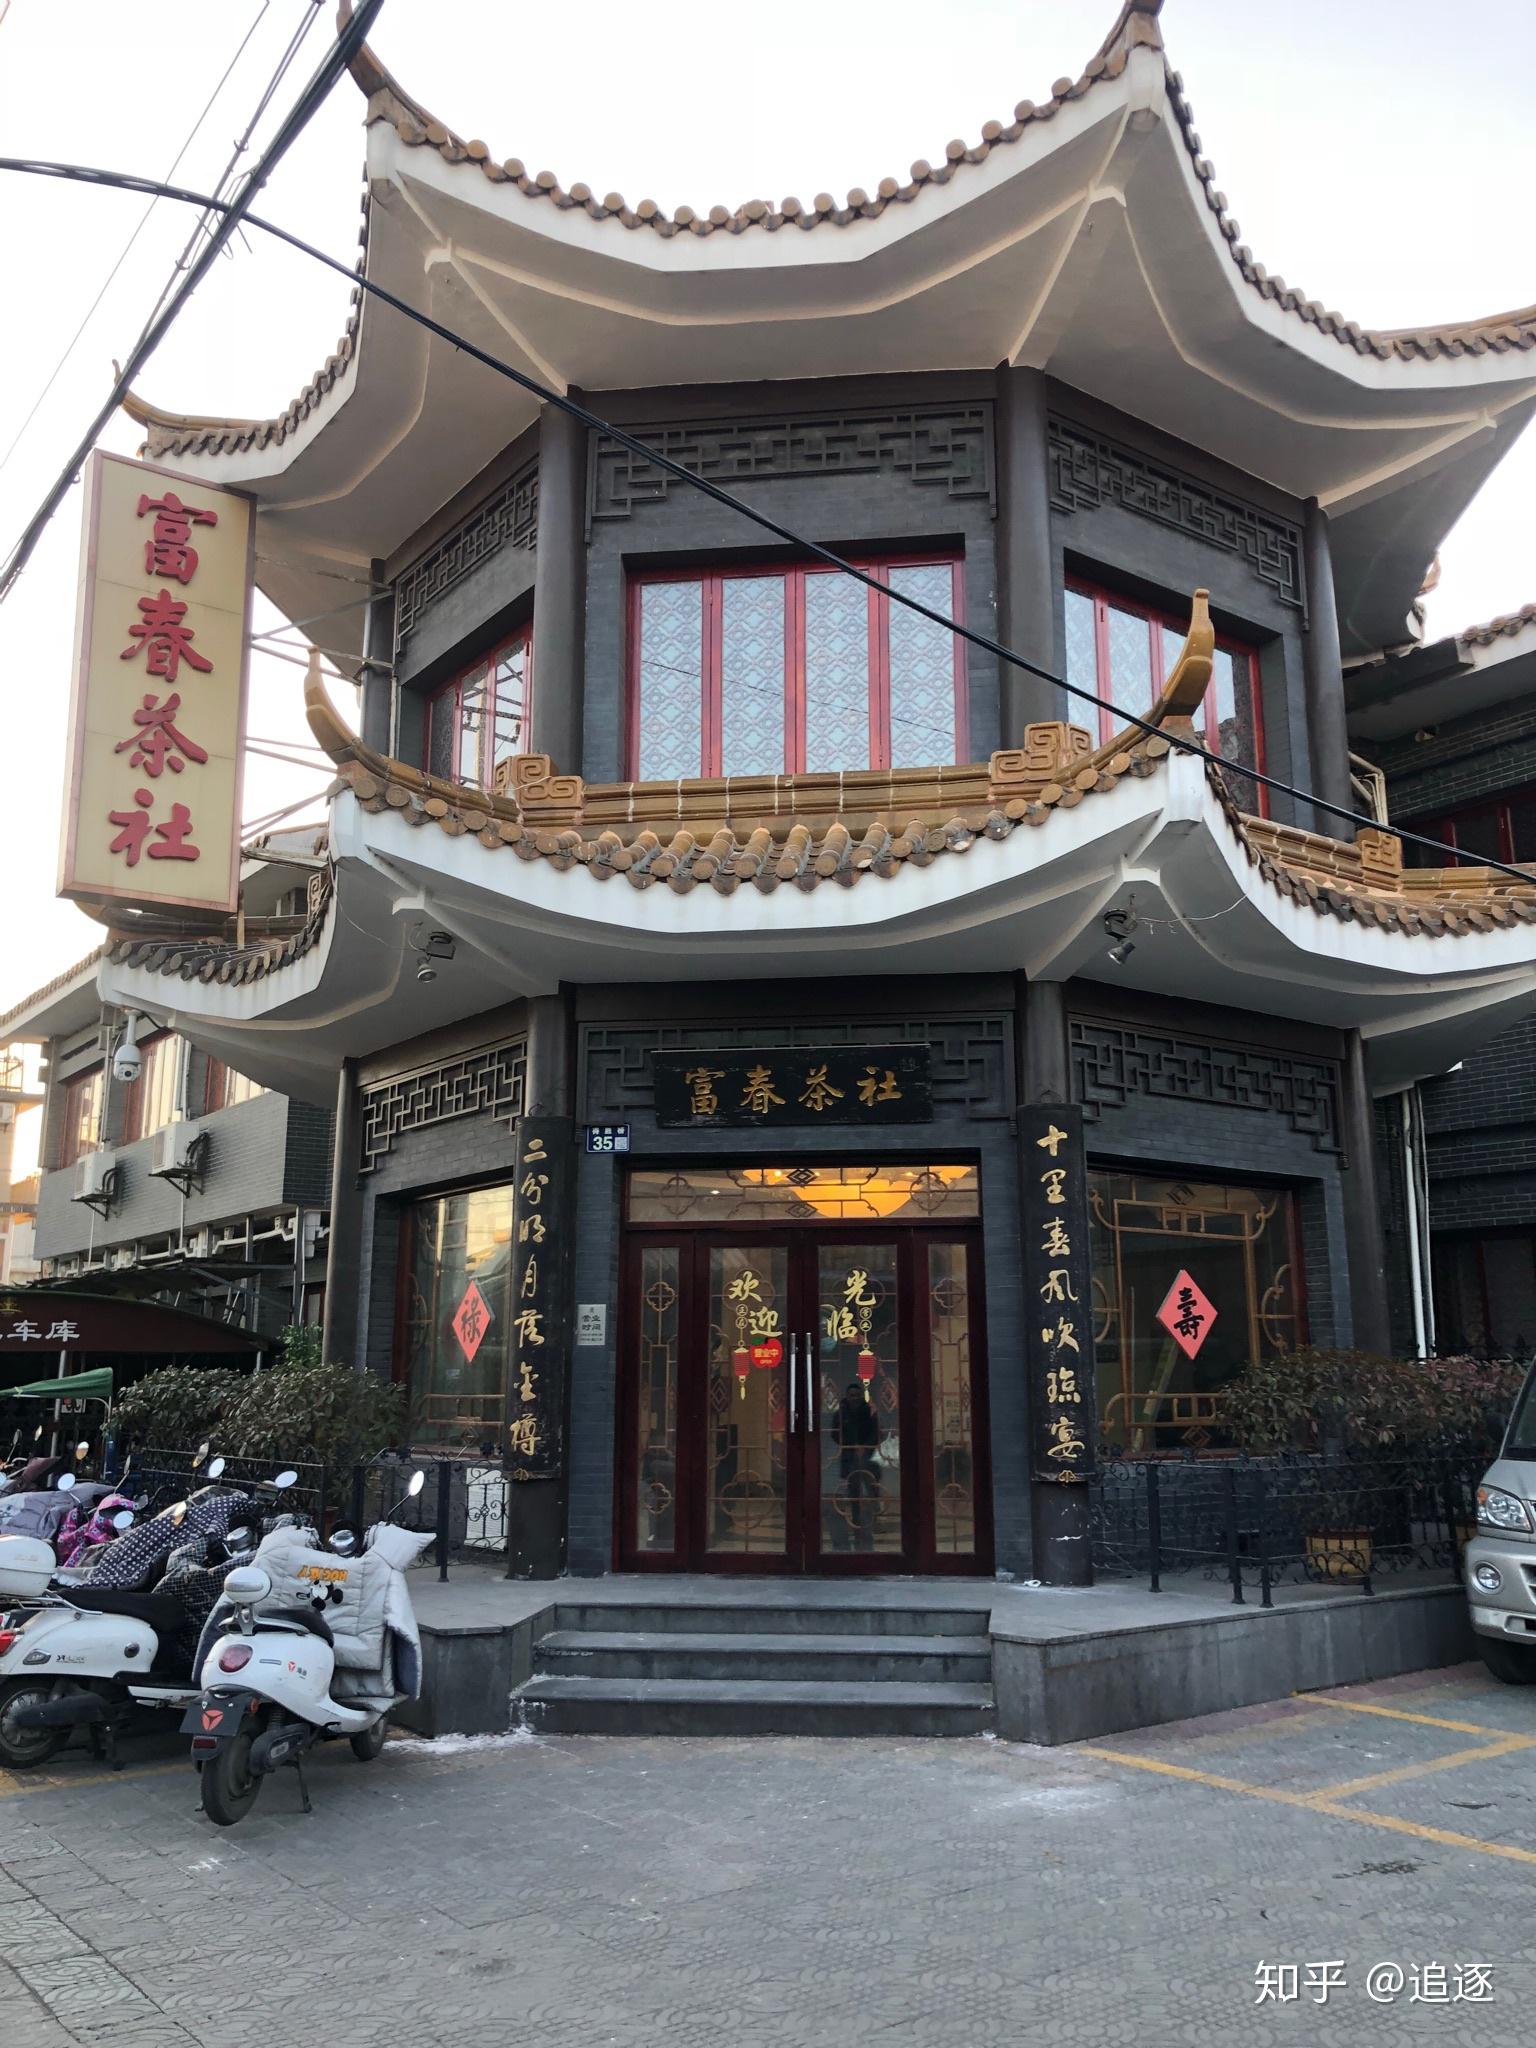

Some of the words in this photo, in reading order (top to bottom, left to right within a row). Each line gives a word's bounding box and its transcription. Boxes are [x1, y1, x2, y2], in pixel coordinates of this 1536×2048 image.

[108, 491, 218, 867] 富春茶社
[685, 1064, 903, 1114] 富春茶社
[592, 1136, 613, 1151] 35
[0, 1319, 80, 1342] 车库
[728, 1271, 783, 1337] 欢迎
[826, 1270, 876, 1341] 光临
